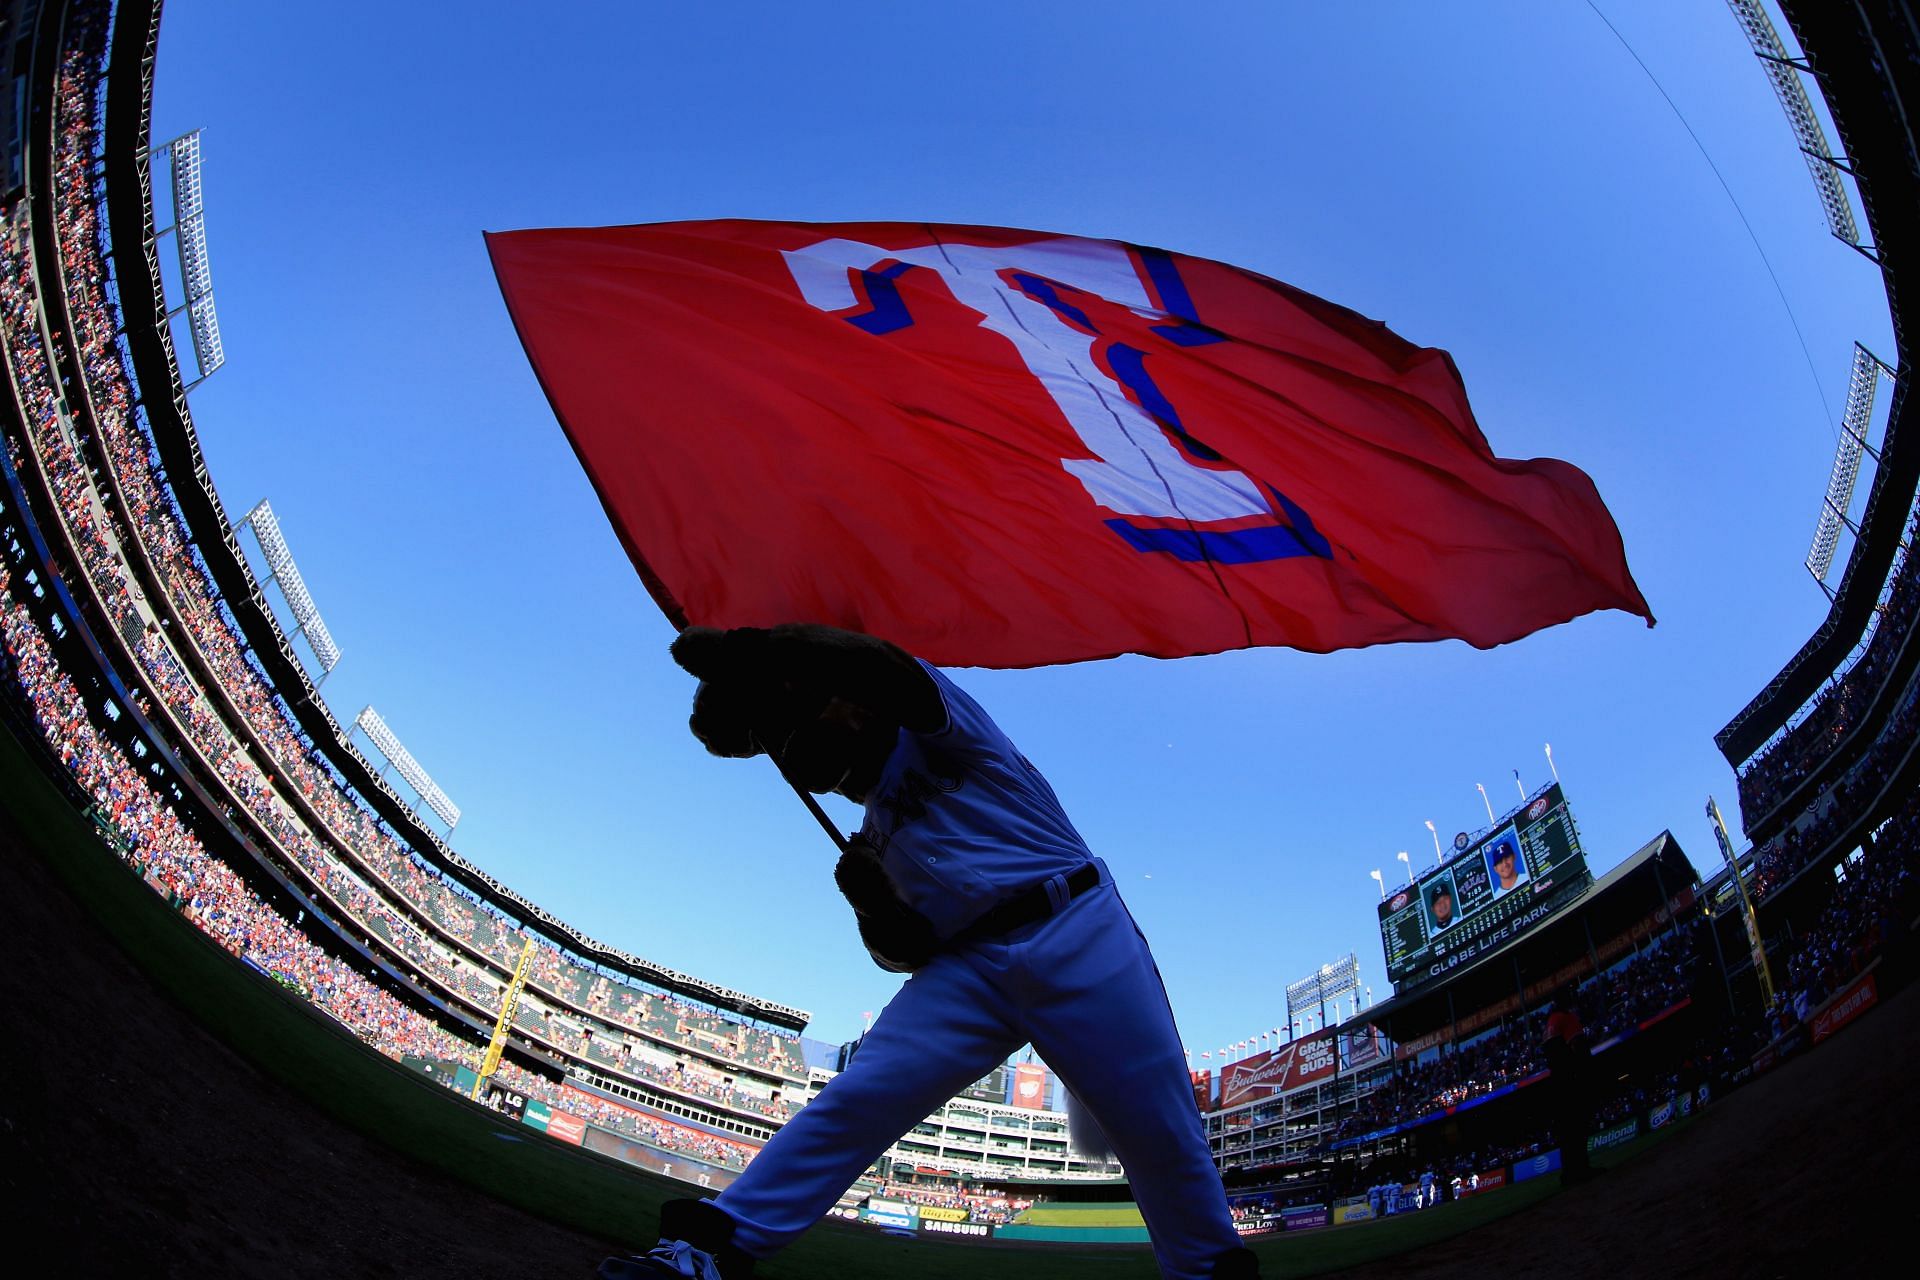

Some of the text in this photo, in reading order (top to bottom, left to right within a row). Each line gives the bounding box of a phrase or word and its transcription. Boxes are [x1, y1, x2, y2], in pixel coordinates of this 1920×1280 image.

[1458, 872, 1486, 894] TEXAS
[1430, 945, 1477, 976] GLOBE
[1479, 926, 1510, 951] LIFE
[1512, 902, 1549, 932] PARK
[1405, 1031, 1442, 1055] CHOLULA
[1224, 1060, 1294, 1090] Budweiser
[1299, 1053, 1335, 1076] BUDS
[505, 1091, 523, 1108] LG
[1593, 1120, 1637, 1148] National
[924, 1219, 988, 1236] SAMSUNG
